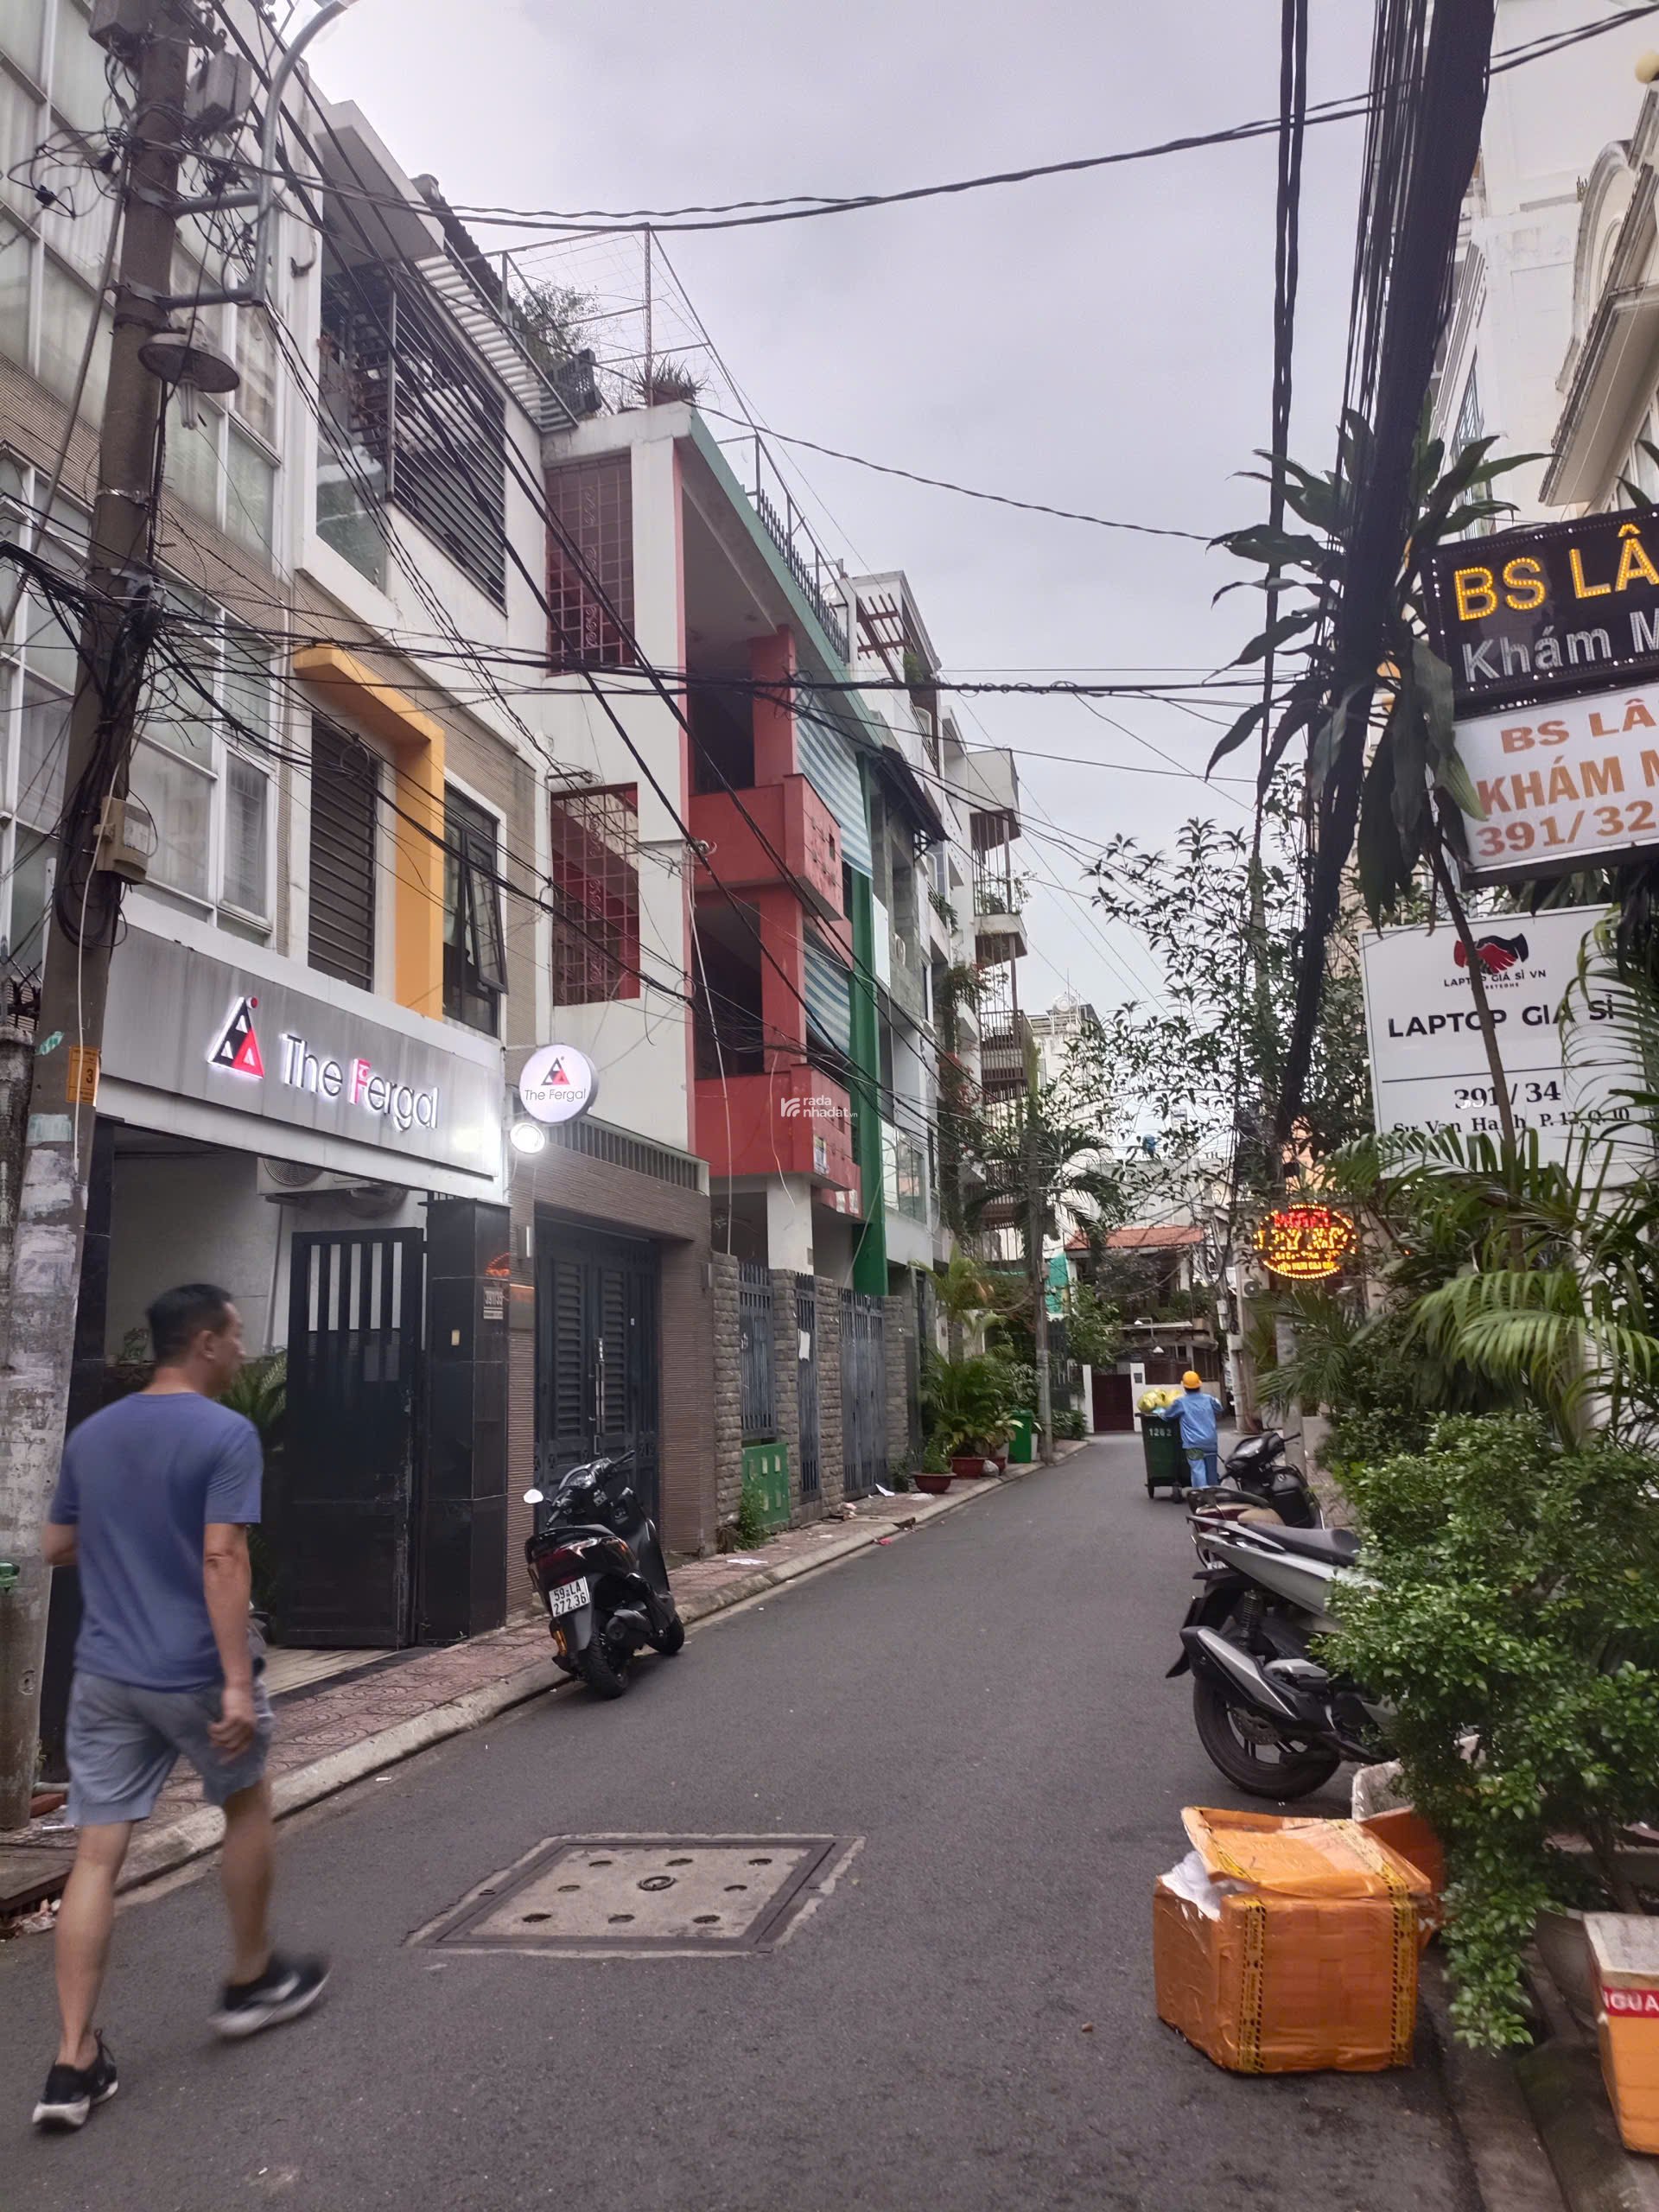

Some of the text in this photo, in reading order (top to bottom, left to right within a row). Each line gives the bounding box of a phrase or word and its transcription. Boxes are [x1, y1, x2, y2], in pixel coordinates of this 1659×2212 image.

[1453, 524, 1659, 620] BS LÂ
[1462, 625, 1612, 683] Khám
[1500, 697, 1657, 754] BS LÂ
[1476, 755, 1625, 816] KHÁM
[1475, 800, 1657, 857] 391/32
[1444, 976, 1487, 988] LAPTP
[1529, 969, 1547, 979] VN
[282, 1033, 439, 1133] The Fergal
[524, 1088, 587, 1103] The Fergal
